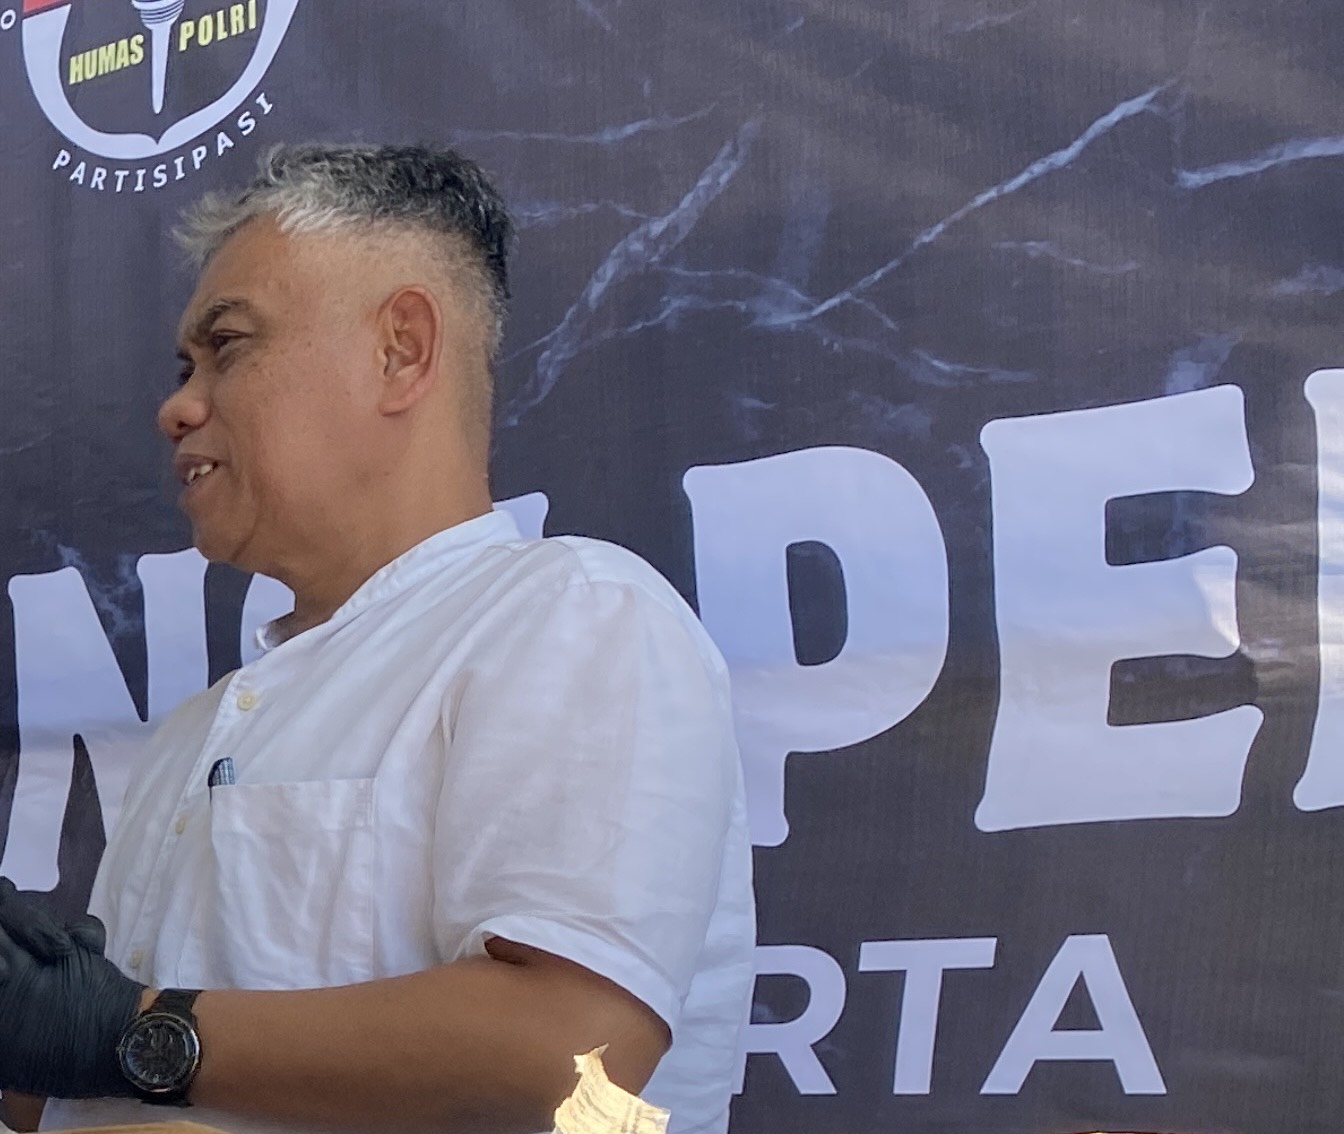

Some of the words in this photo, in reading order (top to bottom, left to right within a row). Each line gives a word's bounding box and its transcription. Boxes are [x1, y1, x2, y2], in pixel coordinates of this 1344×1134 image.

[69, 34, 145, 86] HUMAS
[178, 0, 258, 52] POLRI
[51, 92, 274, 193] PARTISIPASI
[682, 367, 1344, 848] PE
